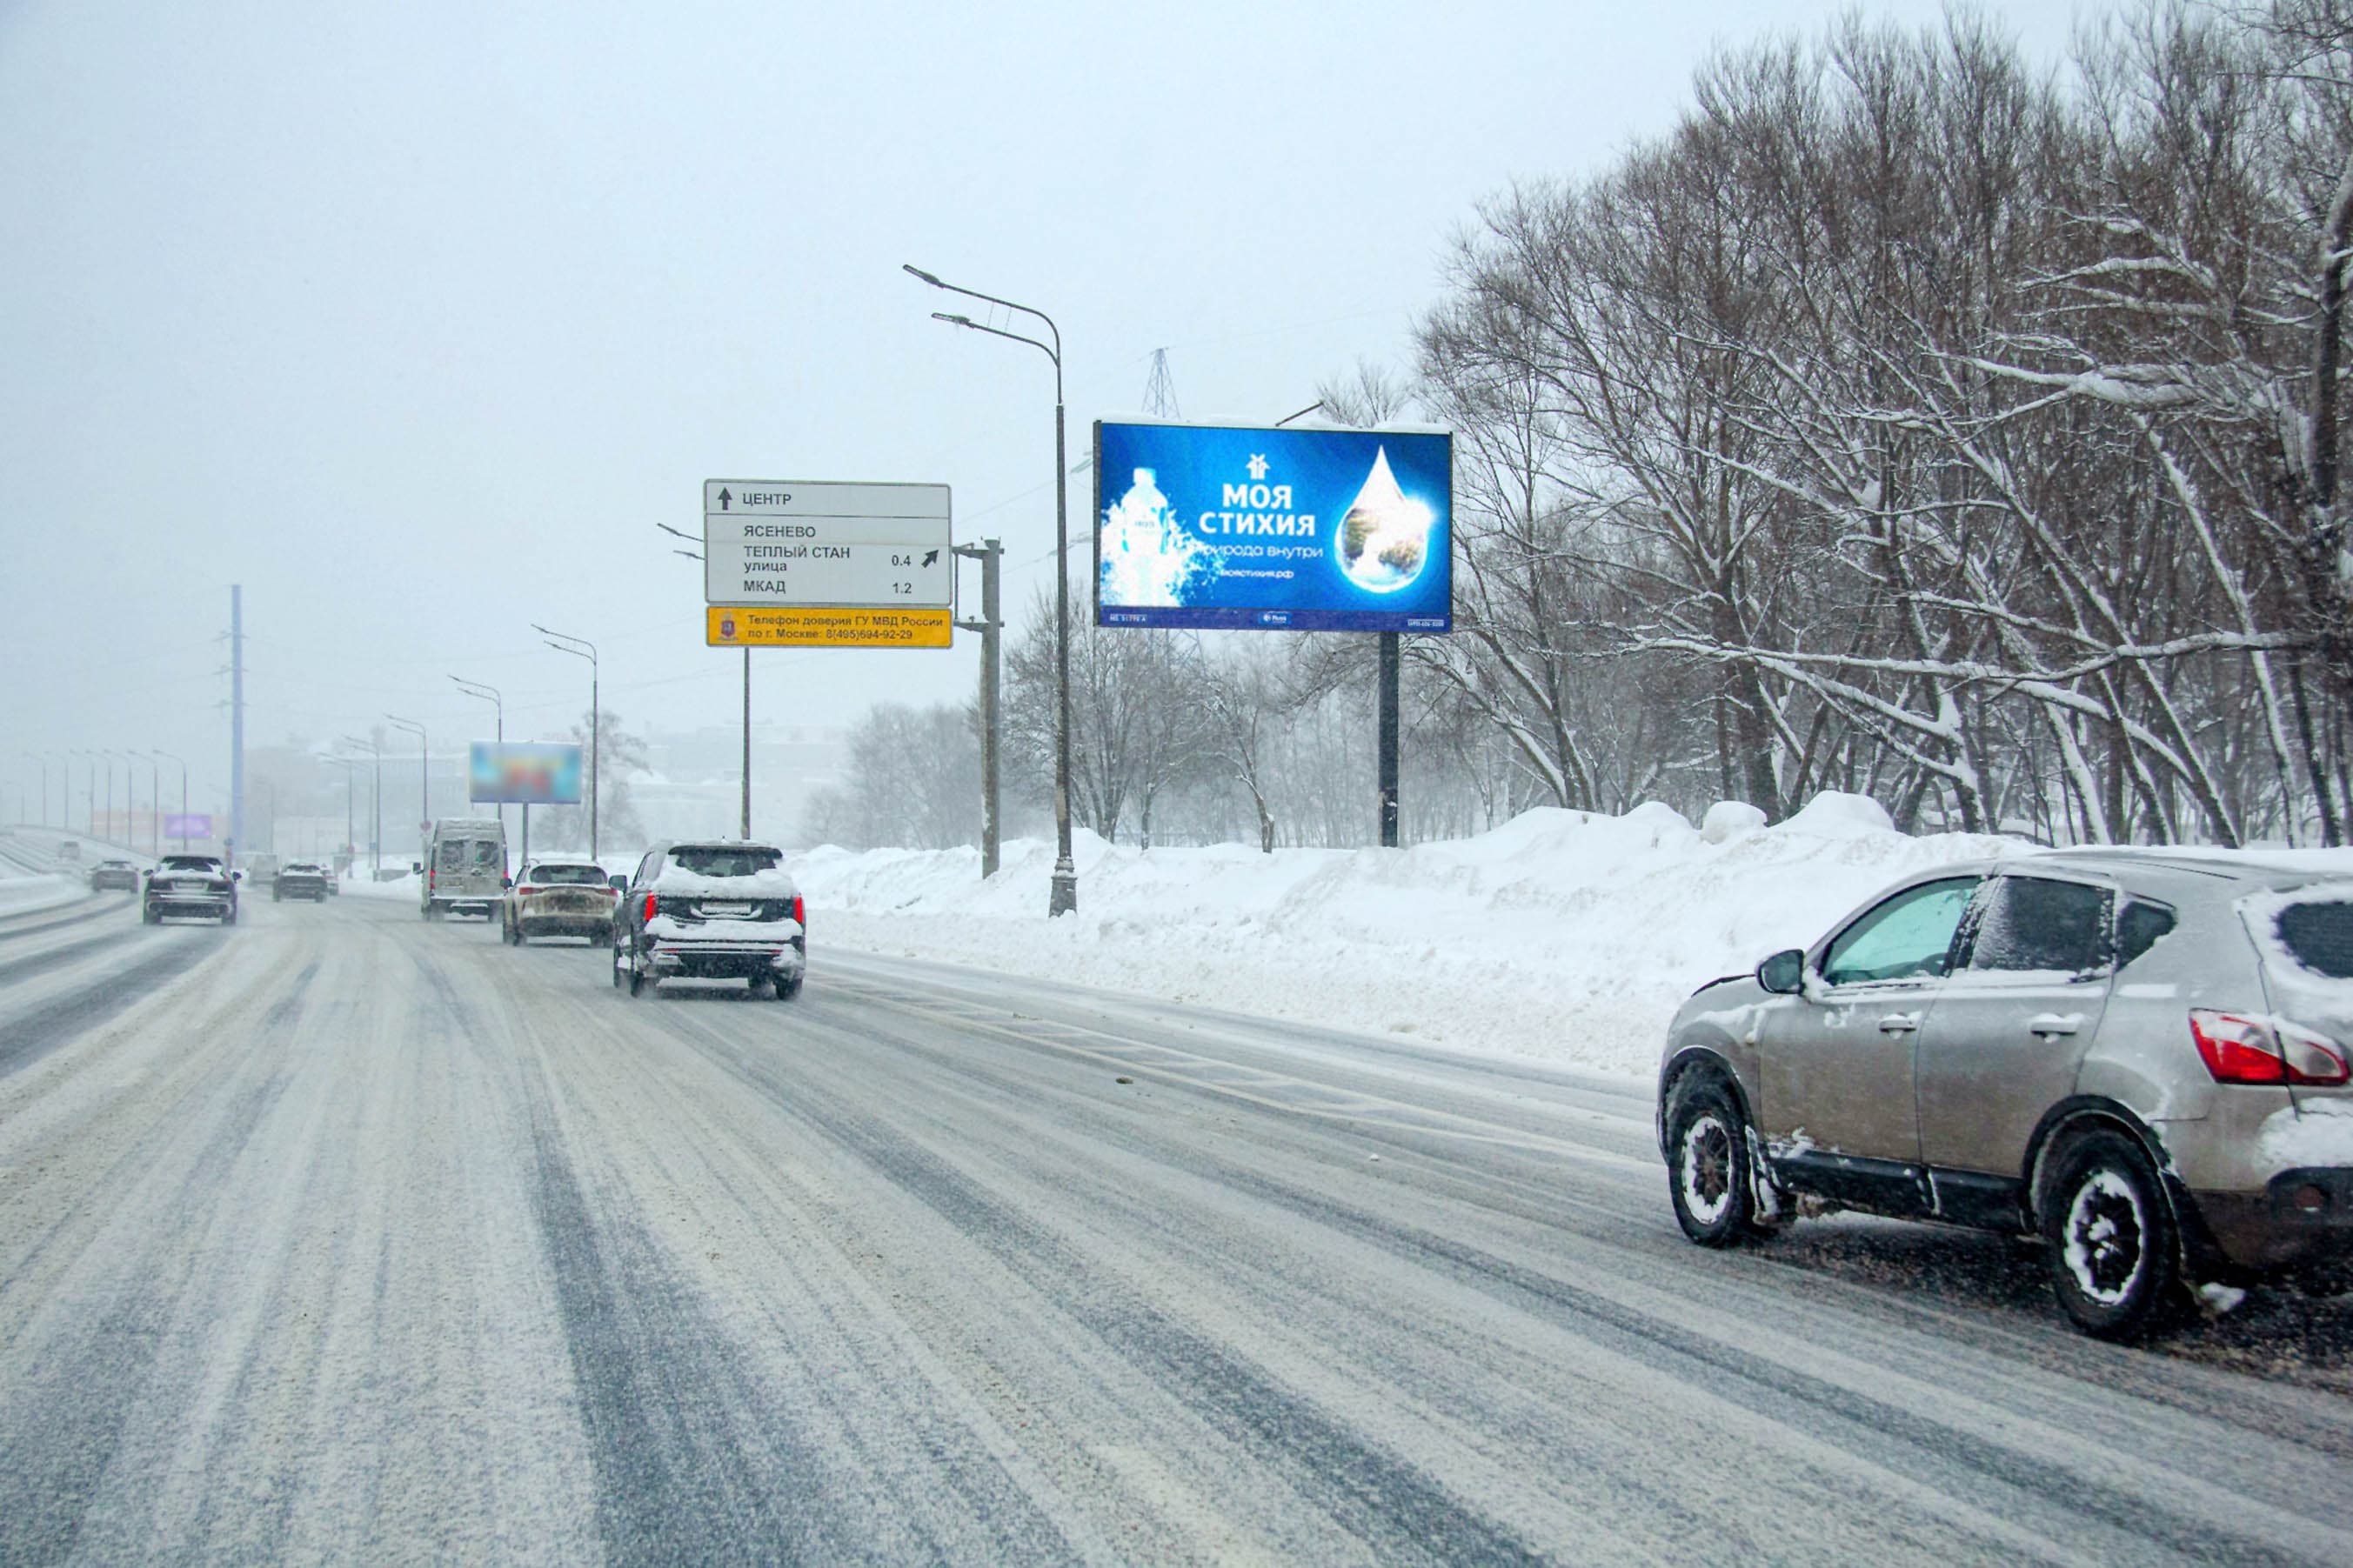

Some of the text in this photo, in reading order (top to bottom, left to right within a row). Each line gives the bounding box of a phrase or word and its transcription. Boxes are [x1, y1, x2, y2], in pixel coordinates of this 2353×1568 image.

[742, 493, 792, 506] ЦЕНТР
[1222, 484, 1293, 510] МОЯ
[1199, 511, 1316, 536] СТИХИЯ
[744, 525, 816, 537] ЯСЕНЕВО
[744, 545, 850, 558] ТЕПЛЫЙ СТАН
[1267, 545, 1324, 559] внутри
[891, 555, 912, 566] 0.4
[744, 562, 787, 574] улица
[744, 581, 912, 594] МКАД 1.2
[748, 614, 943, 627] Телефон доверия ГУ МВД России
[748, 630, 763, 638] по
